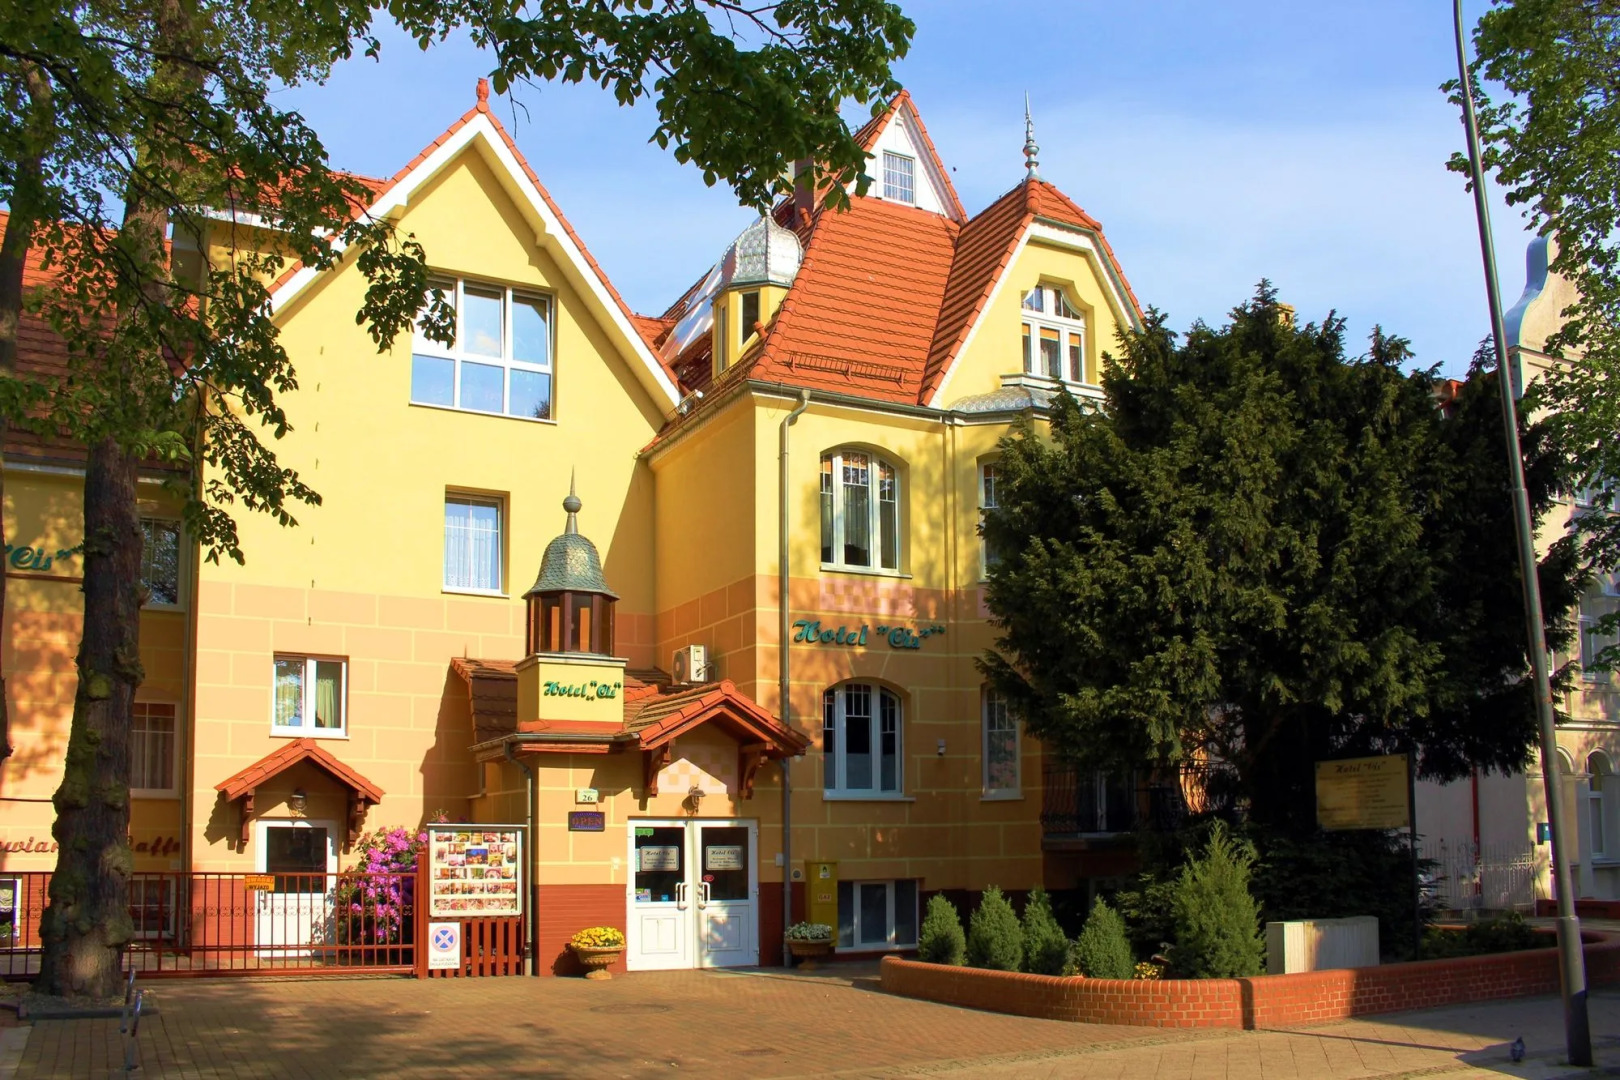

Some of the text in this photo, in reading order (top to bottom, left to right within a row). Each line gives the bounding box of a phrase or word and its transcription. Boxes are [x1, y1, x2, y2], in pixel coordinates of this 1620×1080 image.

[792, 619, 869, 646] Hotel
[543, 681, 587, 698] Hotel
[582, 794, 593, 802] 26
